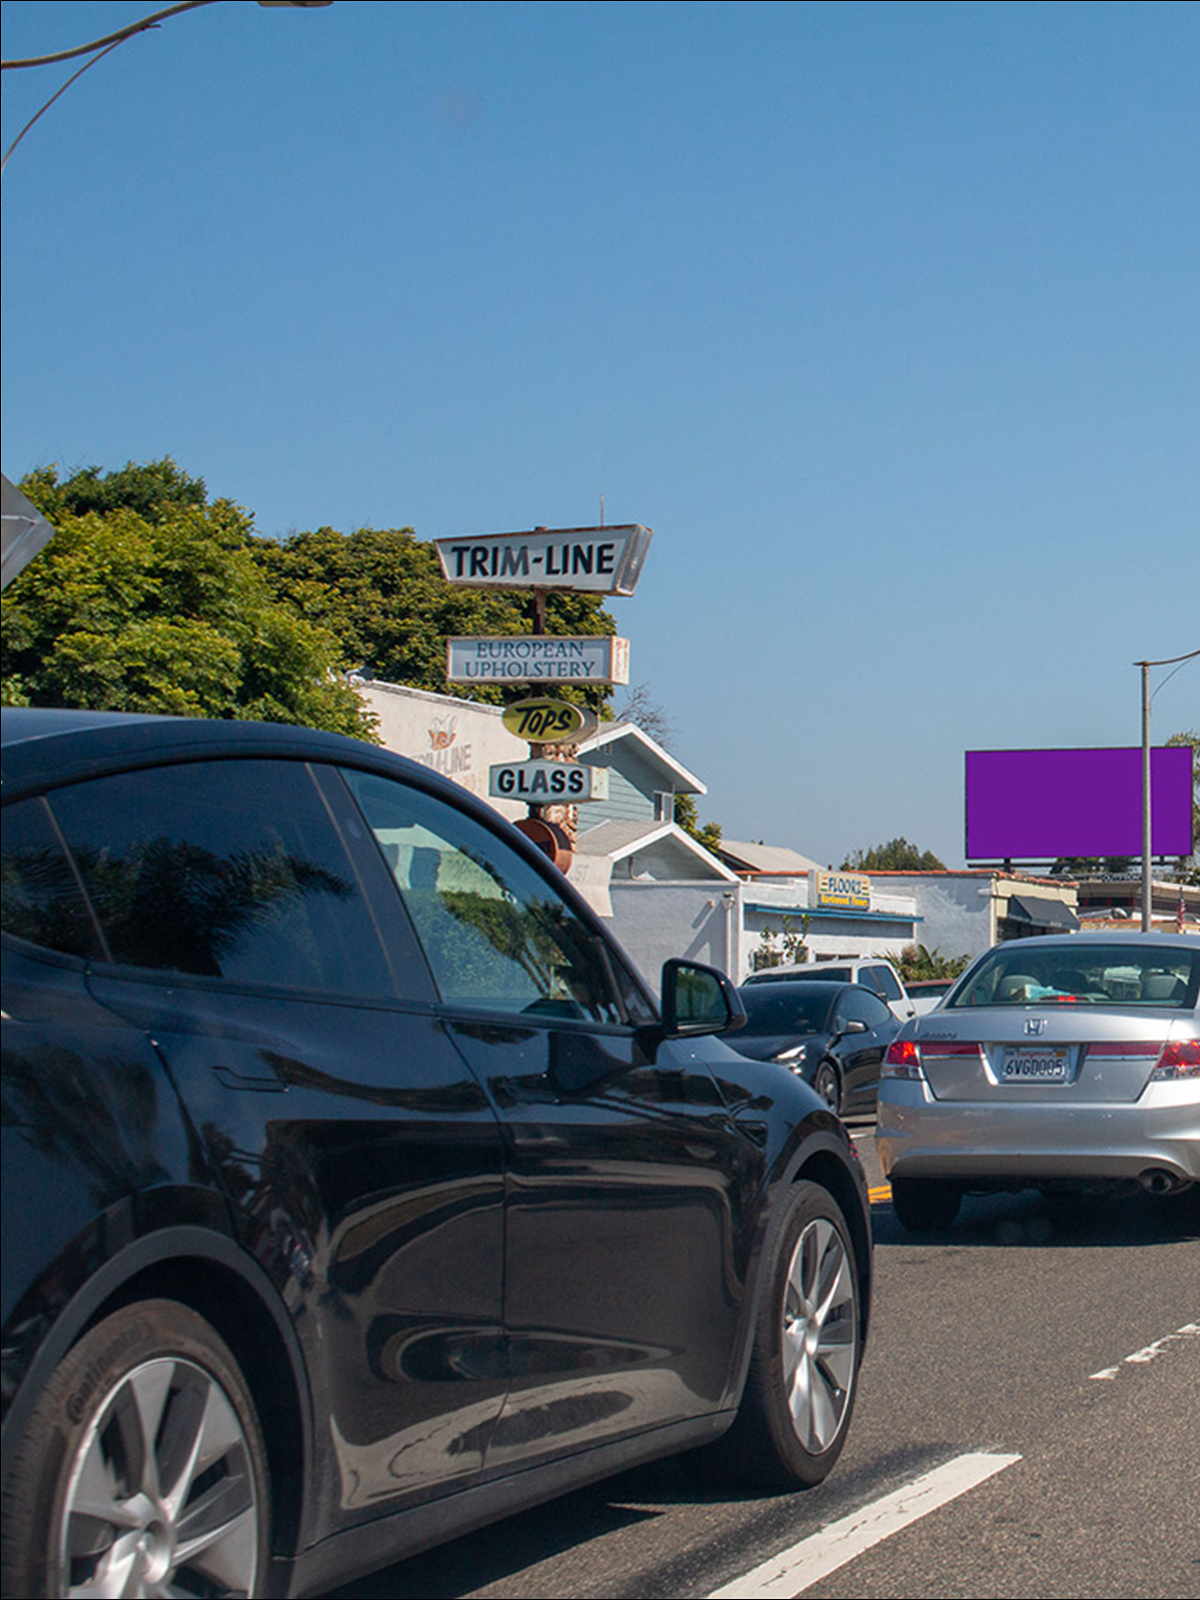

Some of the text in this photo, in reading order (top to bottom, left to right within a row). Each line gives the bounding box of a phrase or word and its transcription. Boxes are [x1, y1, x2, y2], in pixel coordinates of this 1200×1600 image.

[451, 543, 615, 577] TRIM-LINE
[476, 641, 584, 658] EUROPEAN
[465, 661, 595, 677] UPHOLSTERY
[515, 704, 572, 737] TOPS
[498, 769, 584, 794] GLASS
